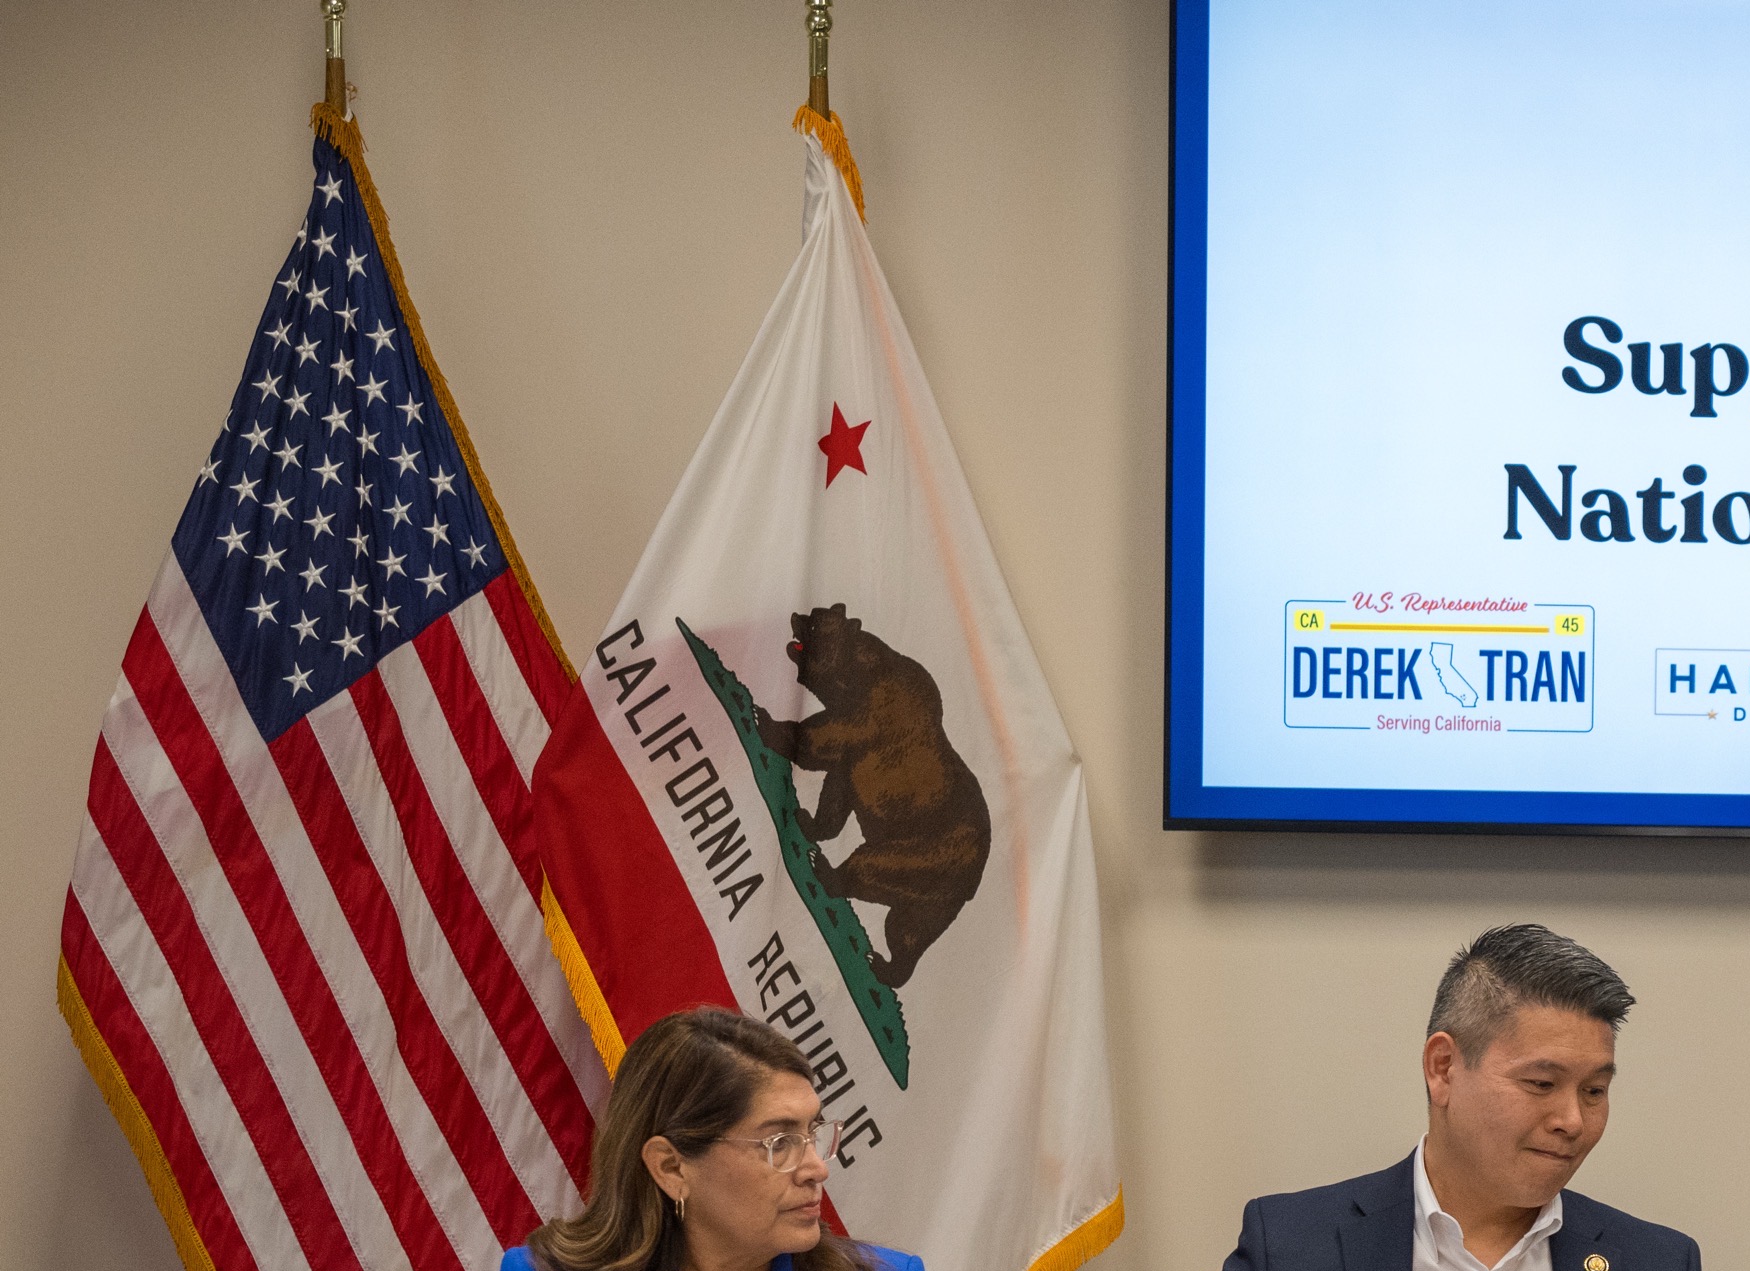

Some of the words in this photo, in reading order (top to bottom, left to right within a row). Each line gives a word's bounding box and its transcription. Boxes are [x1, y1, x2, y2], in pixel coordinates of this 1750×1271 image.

[1352, 591, 1395, 614] U.S.
[1400, 591, 1528, 615] Representative
[1299, 612, 1320, 629] CA
[1561, 617, 1580, 633] 45
[1293, 646, 1423, 700] DEREK
[1479, 650, 1586, 702] TRAN
[1376, 714, 1430, 734] Serving
[1435, 715, 1502, 732] California
[596, 618, 765, 923] CALIFORNIA
